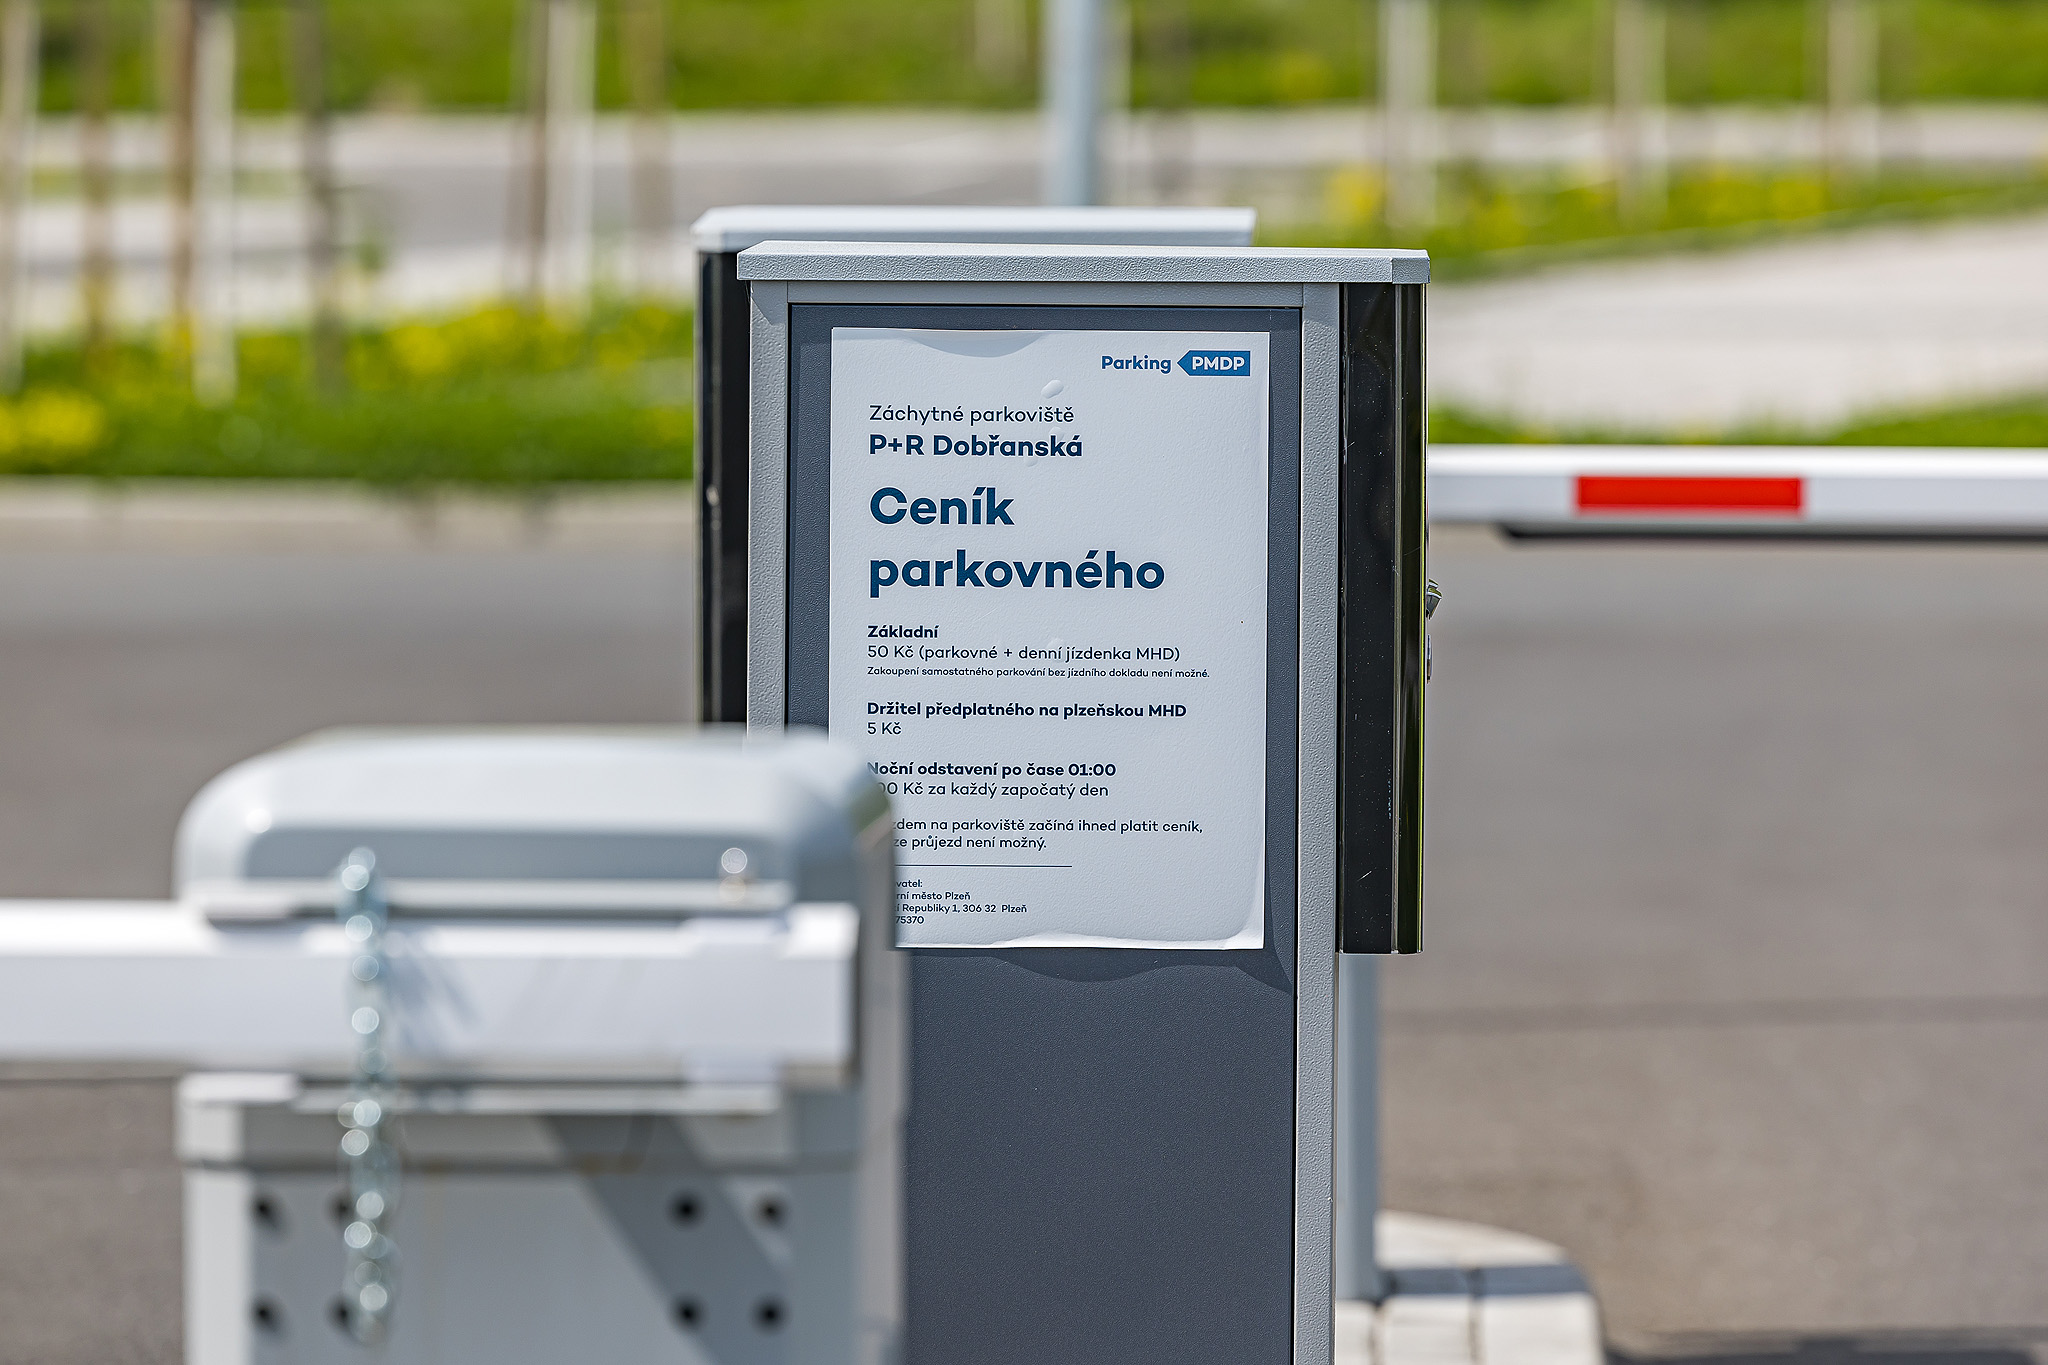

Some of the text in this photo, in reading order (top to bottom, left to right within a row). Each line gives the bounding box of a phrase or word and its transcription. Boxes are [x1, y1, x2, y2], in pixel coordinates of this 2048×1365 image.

[1101, 355, 1246, 374] Parking PMDP
[869, 404, 1075, 426] Záchytné parkoviště
[869, 434, 1083, 457] P+R Dobřanská
[869, 486, 1015, 526] Ceník
[869, 549, 1165, 599] parkovného
[867, 624, 940, 639] Základní
[867, 644, 1180, 663] 50 Kč (parkovné + denní jízdenka MHD)
[867, 666, 1210, 679] Zakoupení samostatného parkování bez jízdního dokladu není možné.
[867, 702, 1187, 720] Držitel předplatného na plzeňskou MHD
[867, 721, 902, 735] 5 Kč
[917, 762, 999, 776] odstavení
[1001, 766, 1022, 780] po
[1026, 762, 1065, 777] čase
[1068, 763, 1117, 777] 01:00
[903, 782, 924, 795] Kč
[927, 785, 946, 795] za
[950, 782, 998, 800] každý
[1001, 782, 1076, 800] započatý
[1079, 782, 1109, 796] den
[930, 820, 948, 831] na
[952, 819, 1025, 834] parkoviště
[1028, 819, 1074, 832] začíná
[1077, 819, 1117, 832] ihned
[1120, 820, 1159, 835] platit
[1162, 820, 1203, 834] ceník,
[911, 834, 963, 851] průjezd
[966, 836, 996, 848] není
[999, 836, 1047, 851] možný.
[911, 891, 943, 900] město
[944, 891, 971, 901] Plzeň
[902, 903, 951, 915] Republiky
[952, 904, 961, 914] 1,
[962, 904, 983, 913] 306
[984, 904, 997, 913] 32
[1001, 903, 1028, 914] Plzeň
